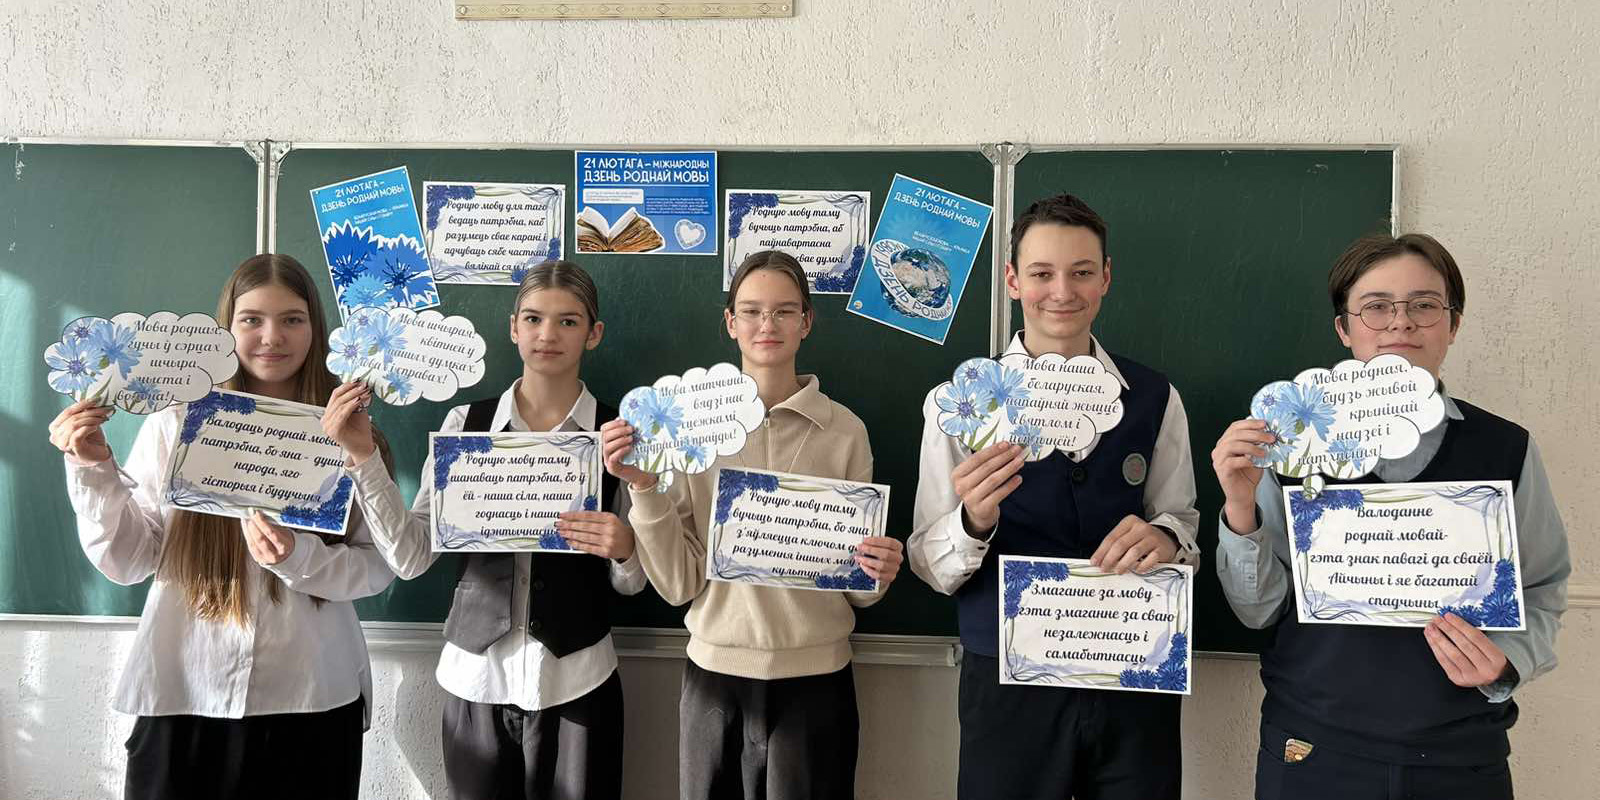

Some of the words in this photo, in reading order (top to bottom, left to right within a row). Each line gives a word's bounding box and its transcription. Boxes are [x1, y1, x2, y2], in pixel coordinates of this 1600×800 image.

[584, 158, 595, 169] 21
[599, 158, 644, 169] ЛЮТАГА
[653, 160, 709, 169] МІЖНАРОДНЫ
[584, 171, 620, 183] ДЗЕНЬ
[624, 170, 671, 183] РОДНАЙ
[673, 171, 709, 183] МОВЫ
[335, 189, 344, 198] 21
[346, 180, 379, 194] ЛЮТАГА
[321, 200, 346, 213] ДЗЕНЬ
[347, 190, 380, 205] РОДНАЙ
[379, 184, 405, 197] МОВЫ
[915, 188, 925, 197] 21
[925, 192, 960, 210] ЛЮТАГА
[447, 201, 479, 211] Родную
[481, 201, 503, 212] мову
[506, 203, 523, 212] для
[752, 207, 785, 217] Родную
[787, 207, 813, 217] мову
[813, 209, 840, 219] таму
[894, 192, 920, 207] ДЗЕНЬ
[921, 201, 954, 219] РОДНАЙ
[954, 215, 980, 228] МОВЫ
[448, 215, 478, 226] ведаць
[528, 218, 545, 226] каб
[749, 222, 781, 233] вучыць
[783, 224, 831, 234] патрэбна,
[832, 224, 845, 232] аб
[445, 233, 489, 241] разумець
[491, 232, 509, 240] свае
[509, 233, 541, 241] карані
[543, 233, 547, 241] і
[760, 238, 832, 249] паўнавартасна
[444, 246, 485, 257] адчуваць
[488, 247, 506, 256] сябе
[509, 249, 546, 257] часткай
[795, 254, 814, 263] свае
[465, 261, 500, 270] вялікай
[134, 320, 168, 333] Мова
[399, 314, 425, 327] Мова
[127, 342, 160, 352] гучы
[162, 340, 170, 354] ў
[174, 342, 221, 354] сэрцах
[420, 335, 465, 353] квітней
[467, 348, 475, 358] у
[1023, 359, 1055, 372] Мова
[1058, 363, 1095, 374] наша
[136, 376, 184, 385] чыста
[185, 374, 191, 385] і
[1311, 372, 1348, 384] Мова
[660, 383, 686, 397] Мова
[1322, 389, 1362, 404] будзь
[1365, 380, 1417, 396] жывой
[693, 395, 723, 409] вядзі
[725, 395, 744, 404] нас
[1005, 396, 1069, 412] напаўняй
[1071, 401, 1120, 415] жыццё
[1349, 402, 1419, 421] крыніцай
[1075, 418, 1081, 429] і
[206, 415, 264, 433] Валодаць
[264, 426, 307, 441] роднай
[308, 434, 342, 447] мова
[1336, 424, 1383, 443] надзеі
[1386, 423, 1391, 435] і
[200, 435, 262, 454] патрэбна,
[264, 445, 278, 455] бо
[279, 450, 302, 460] яна
[313, 455, 344, 468] душа
[464, 454, 505, 467] Родную
[507, 455, 538, 467] мову
[538, 455, 572, 467] таму
[233, 460, 278, 476] народа,
[280, 468, 300, 478] яго
[451, 472, 504, 485] шанаваць
[506, 473, 562, 485] патрэбна,
[565, 474, 576, 483] бо
[579, 474, 586, 485] ў
[201, 475, 256, 494] гісторыя
[258, 483, 264, 494] і
[264, 482, 321, 502] будучыня
[462, 490, 474, 500] ёй
[515, 492, 540, 501] сіла,
[749, 491, 790, 508] Родную
[791, 500, 823, 513] мову
[823, 502, 857, 517] таму
[475, 511, 522, 522] годнасць
[525, 508, 529, 517] і
[1357, 506, 1433, 520] Валоданне
[732, 508, 772, 526] вучыць
[775, 517, 831, 532] патрэбна,
[834, 522, 846, 532] бо
[848, 526, 870, 536] яна
[1344, 529, 1395, 544] роднай
[800, 538, 846, 550] ключом
[732, 543, 793, 560] разумення
[796, 552, 830, 565] іншых
[1310, 554, 1344, 564] гэта
[1347, 555, 1380, 566] знак
[1382, 552, 1428, 565] павагі
[1432, 554, 1450, 567] да
[1453, 552, 1493, 564] сваёй
[1328, 572, 1384, 585] Айчыны
[1387, 574, 1392, 585] і
[1396, 577, 1412, 586] яе
[1414, 574, 1478, 587] багатай
[1031, 583, 1096, 597] Змаганне
[1099, 590, 1114, 601] за
[1117, 589, 1153, 602] мову
[1018, 607, 1052, 616] гэта
[1055, 609, 1119, 620] змаганне
[1122, 611, 1139, 622] за
[1141, 611, 1174, 622] сваю
[1043, 628, 1140, 644] незалежнасць
[1142, 631, 1149, 642] і
[1045, 649, 1146, 667] самабытнасць
